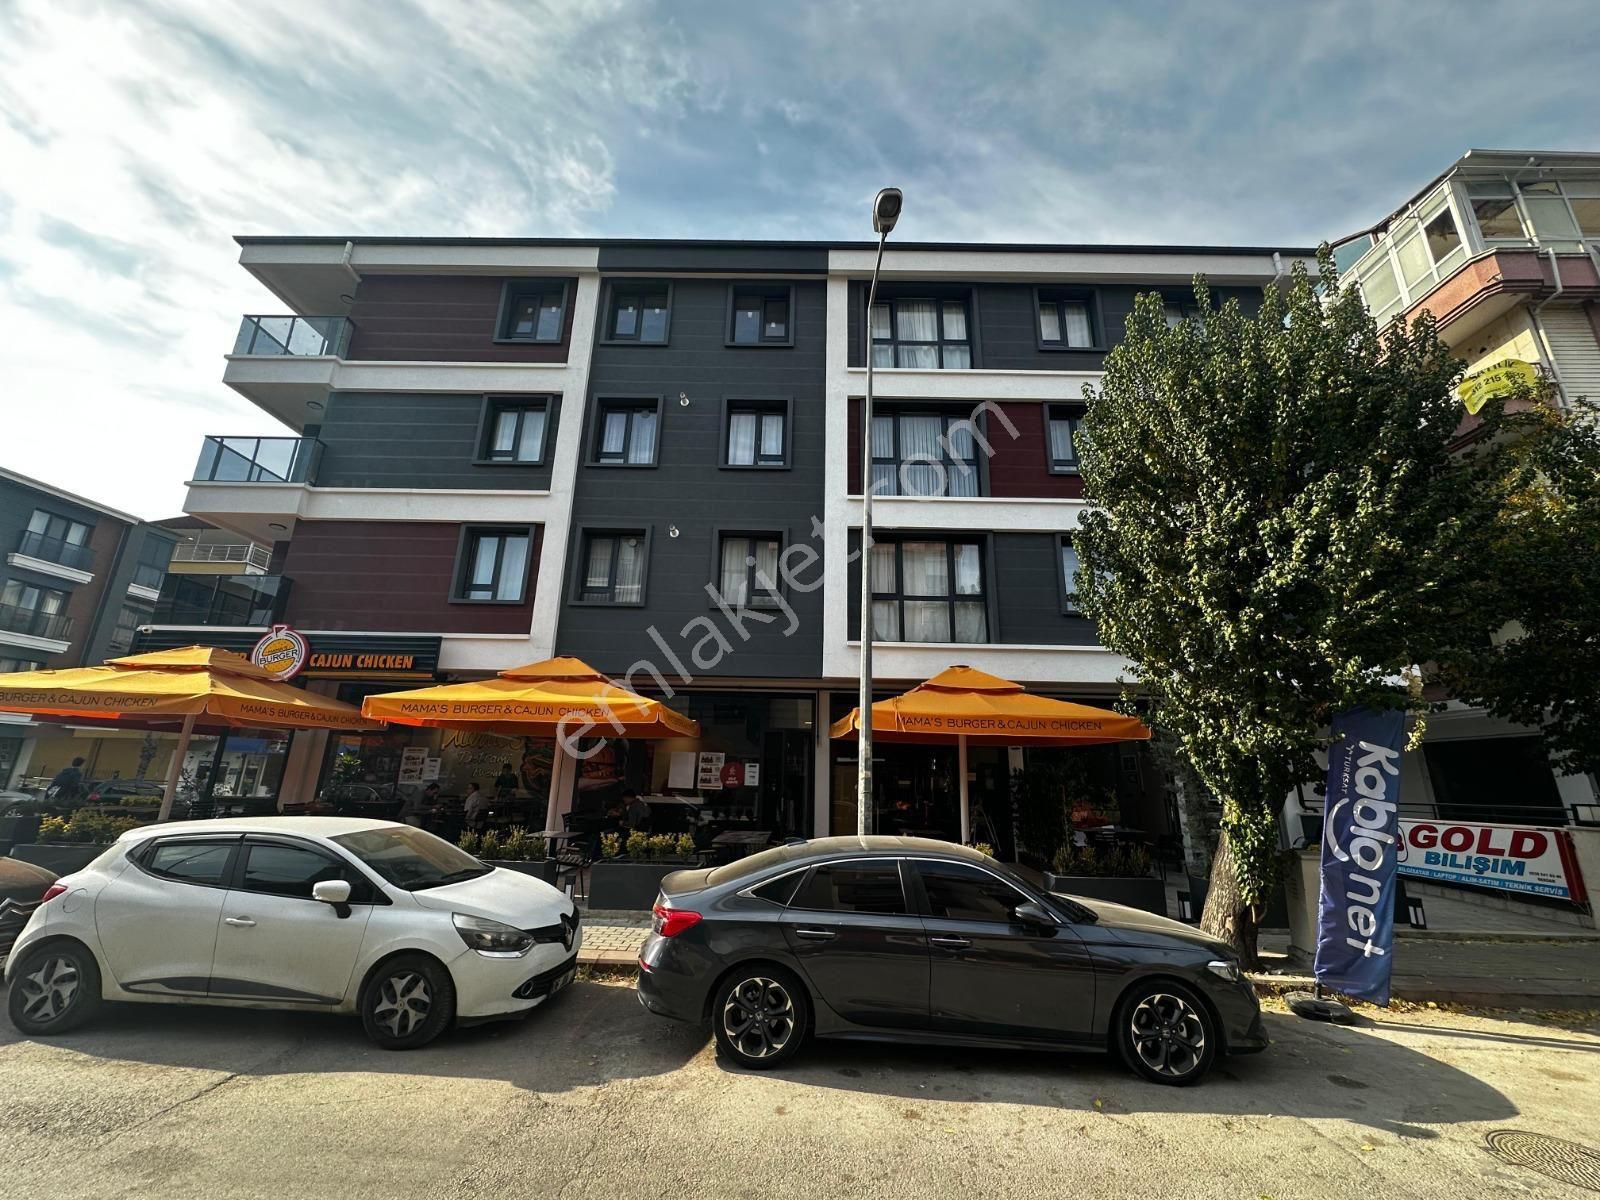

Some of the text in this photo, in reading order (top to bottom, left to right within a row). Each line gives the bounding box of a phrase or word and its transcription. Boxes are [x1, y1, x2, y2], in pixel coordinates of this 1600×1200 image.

[1484, 374, 1502, 386] 215
[259, 649, 298, 665] BURGER
[309, 653, 414, 669] CAJUN CHICKEN
[58, 694, 99, 706] CAJUN
[103, 696, 159, 707] CHICKEN
[240, 703, 275, 717] MAMA'S
[278, 708, 311, 720] BURGER
[401, 703, 449, 714] MAMA'S
[452, 704, 501, 715] BURGER
[513, 705, 554, 716] CAJUN
[558, 707, 610, 718] CHICKEN
[896, 716, 943, 728] MAMA'S
[947, 718, 995, 729] BURGER
[1007, 720, 1047, 730] CAJUN
[1051, 720, 1102, 731] CHICKEN
[1408, 824, 1548, 859] GOLD
[1433, 871, 1457, 880] LAPTOP
